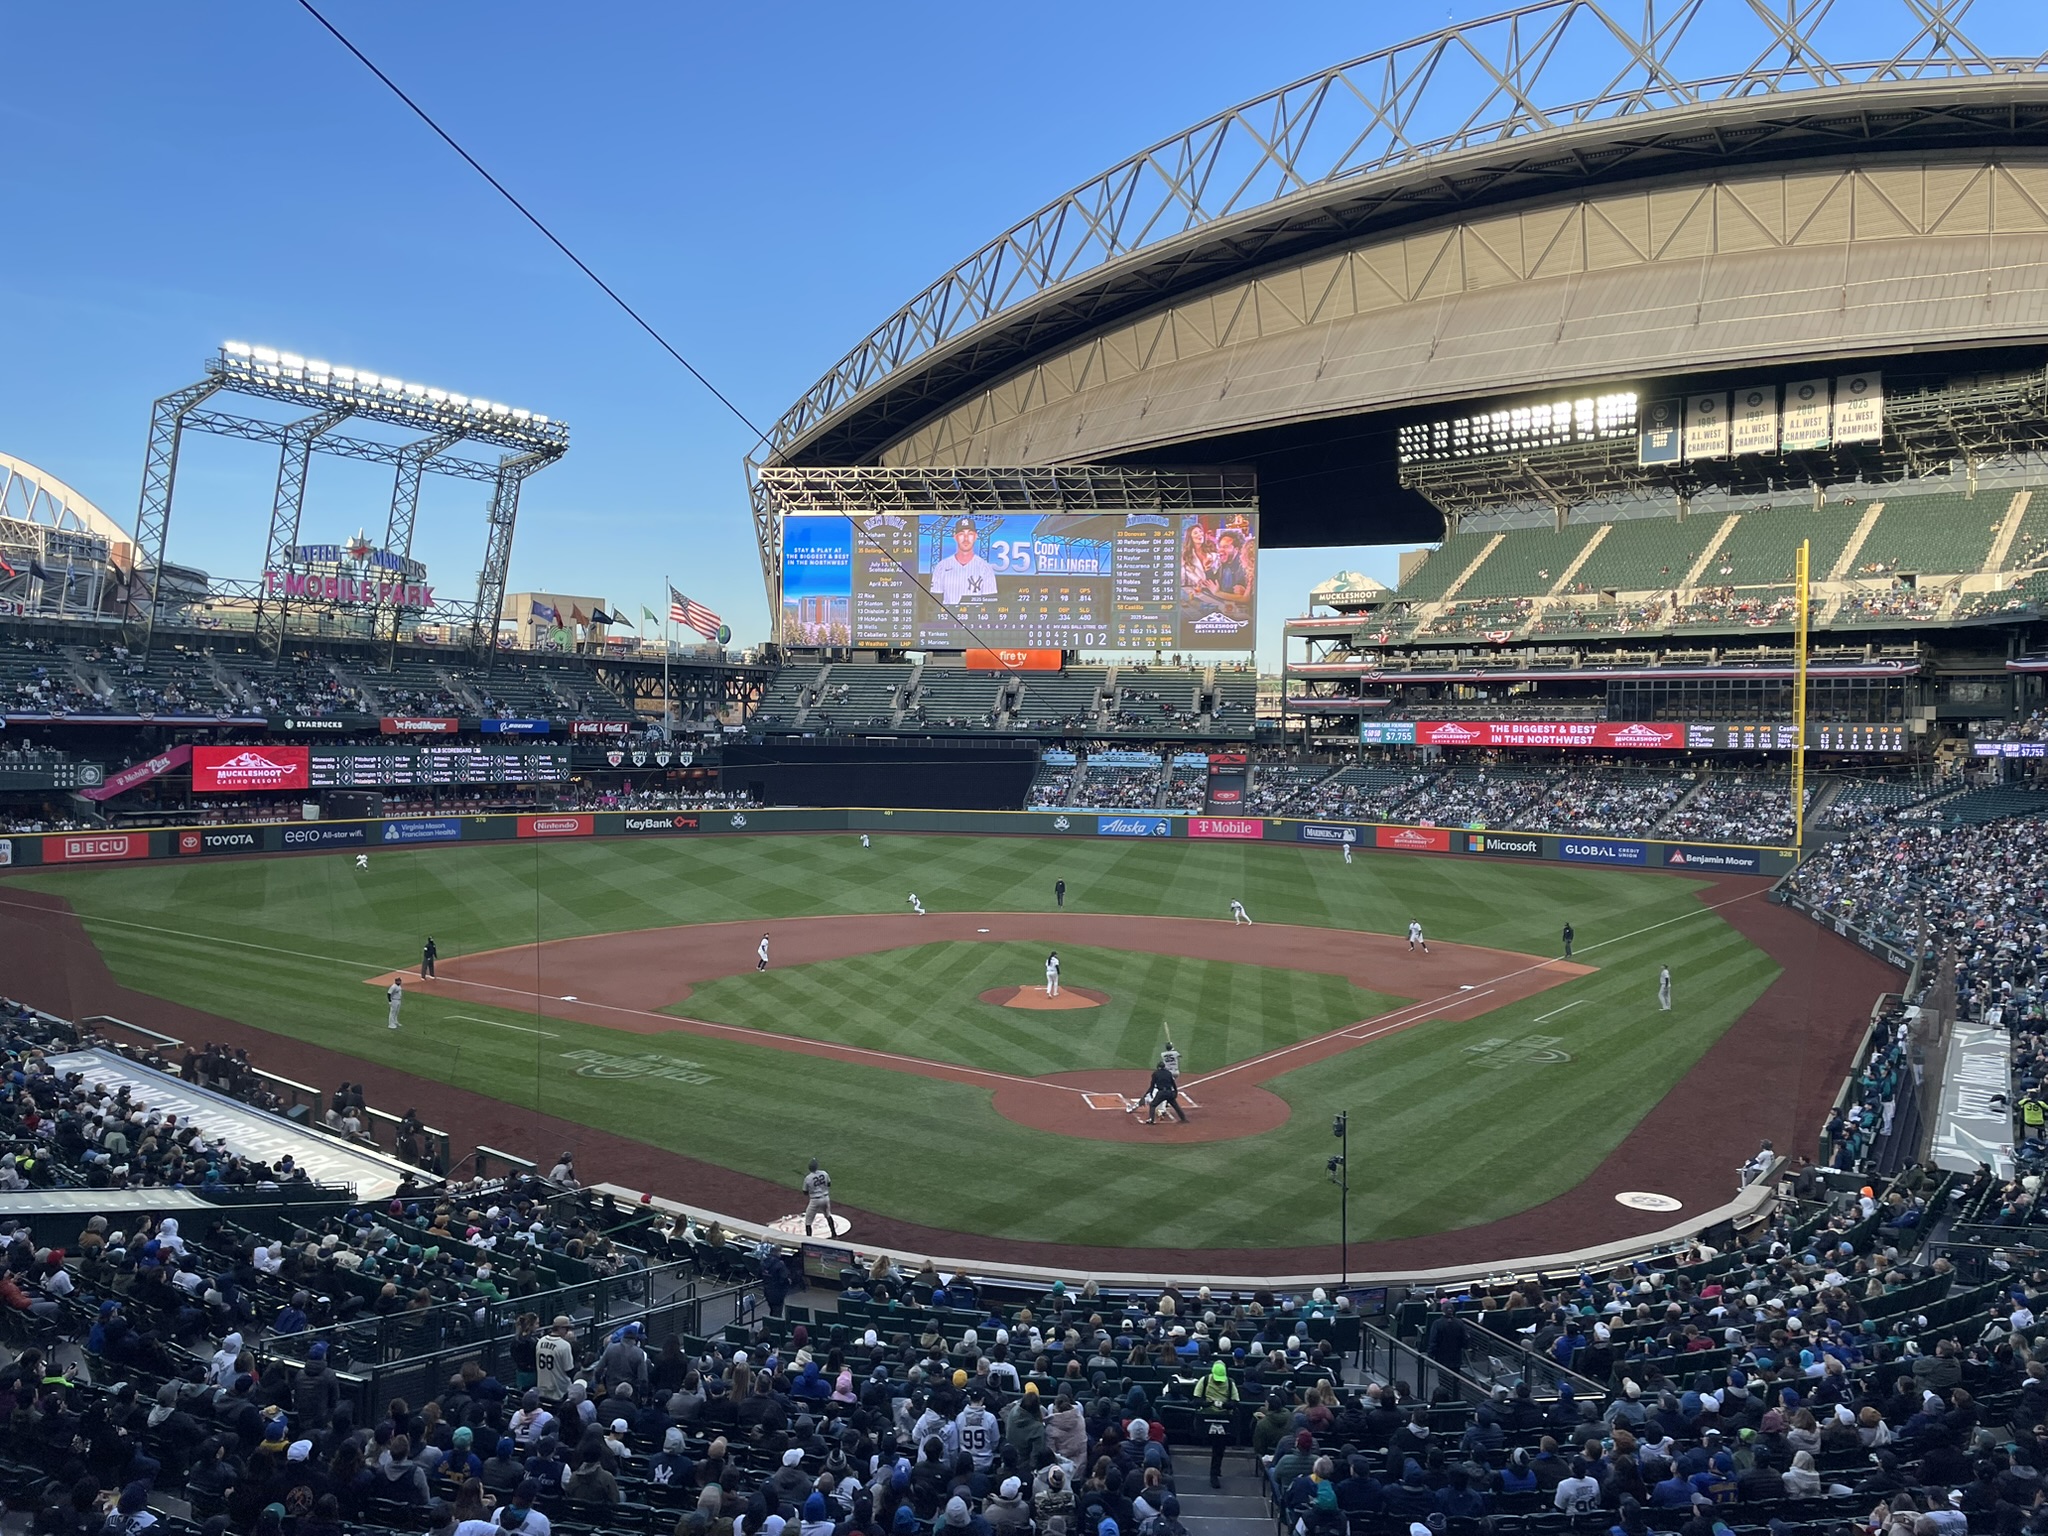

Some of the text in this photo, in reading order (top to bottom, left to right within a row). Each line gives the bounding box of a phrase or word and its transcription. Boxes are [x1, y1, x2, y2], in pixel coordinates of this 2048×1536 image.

[1797, 404, 1816, 416] 2001
[1848, 398, 1868, 410] 2025
[1746, 410, 1764, 422] 1997
[1843, 411, 1873, 422] A.L. WEST
[1739, 423, 1770, 434] A.L. WEST
[1790, 417, 1822, 429] A.L. WEST
[1838, 423, 1877, 435] CHAMPIONS
[1692, 429, 1721, 440] A.L. WEST
[1786, 429, 1825, 441] CHAMPIONS
[1688, 441, 1725, 453] CHAMPIONS
[1735, 435, 1773, 447] CHAMPIONS
[283, 544, 427, 580] SEATTLE MARINERS
[992, 540, 1061, 573] 35 CODY
[1040, 555, 1099, 573] BELLINGER
[262, 570, 435, 607] T-MOBILE PARK
[1319, 591, 1377, 600] MUCKLESHOOT
[1074, 633, 1079, 646] 1
[1086, 633, 1094, 646] 0
[1099, 633, 1107, 646] 2
[1000, 651, 1027, 661] fire tv
[297, 721, 343, 729] STARBUCKS
[1490, 724, 1597, 734] THE BIGGEST & BEST
[1386, 732, 1412, 741] $7,755
[1492, 735, 1594, 745] IN THE NORTHWEST
[2022, 748, 2045, 757] $7,755
[124, 768, 149, 784] Mobile
[218, 770, 281, 779] MUCKLESHOOT
[402, 823, 425, 831] Virginia
[537, 822, 575, 830] Nintendo
[626, 819, 672, 831] KeyBank
[1102, 819, 1147, 834] Alaska
[1212, 821, 1252, 834] Mobile
[205, 835, 254, 846] TOYOTA
[285, 830, 320, 843] eero
[71, 841, 124, 853] BECU
[1487, 838, 1537, 853] Microsoft
[1566, 844, 1616, 857] GLOBAL
[1687, 853, 1754, 866] Benjamin Moore
[1779, 850, 1793, 858] 326
[813, 1174, 826, 1187] 22
[539, 1354, 554, 1370] 68
[963, 1430, 985, 1450] 99
